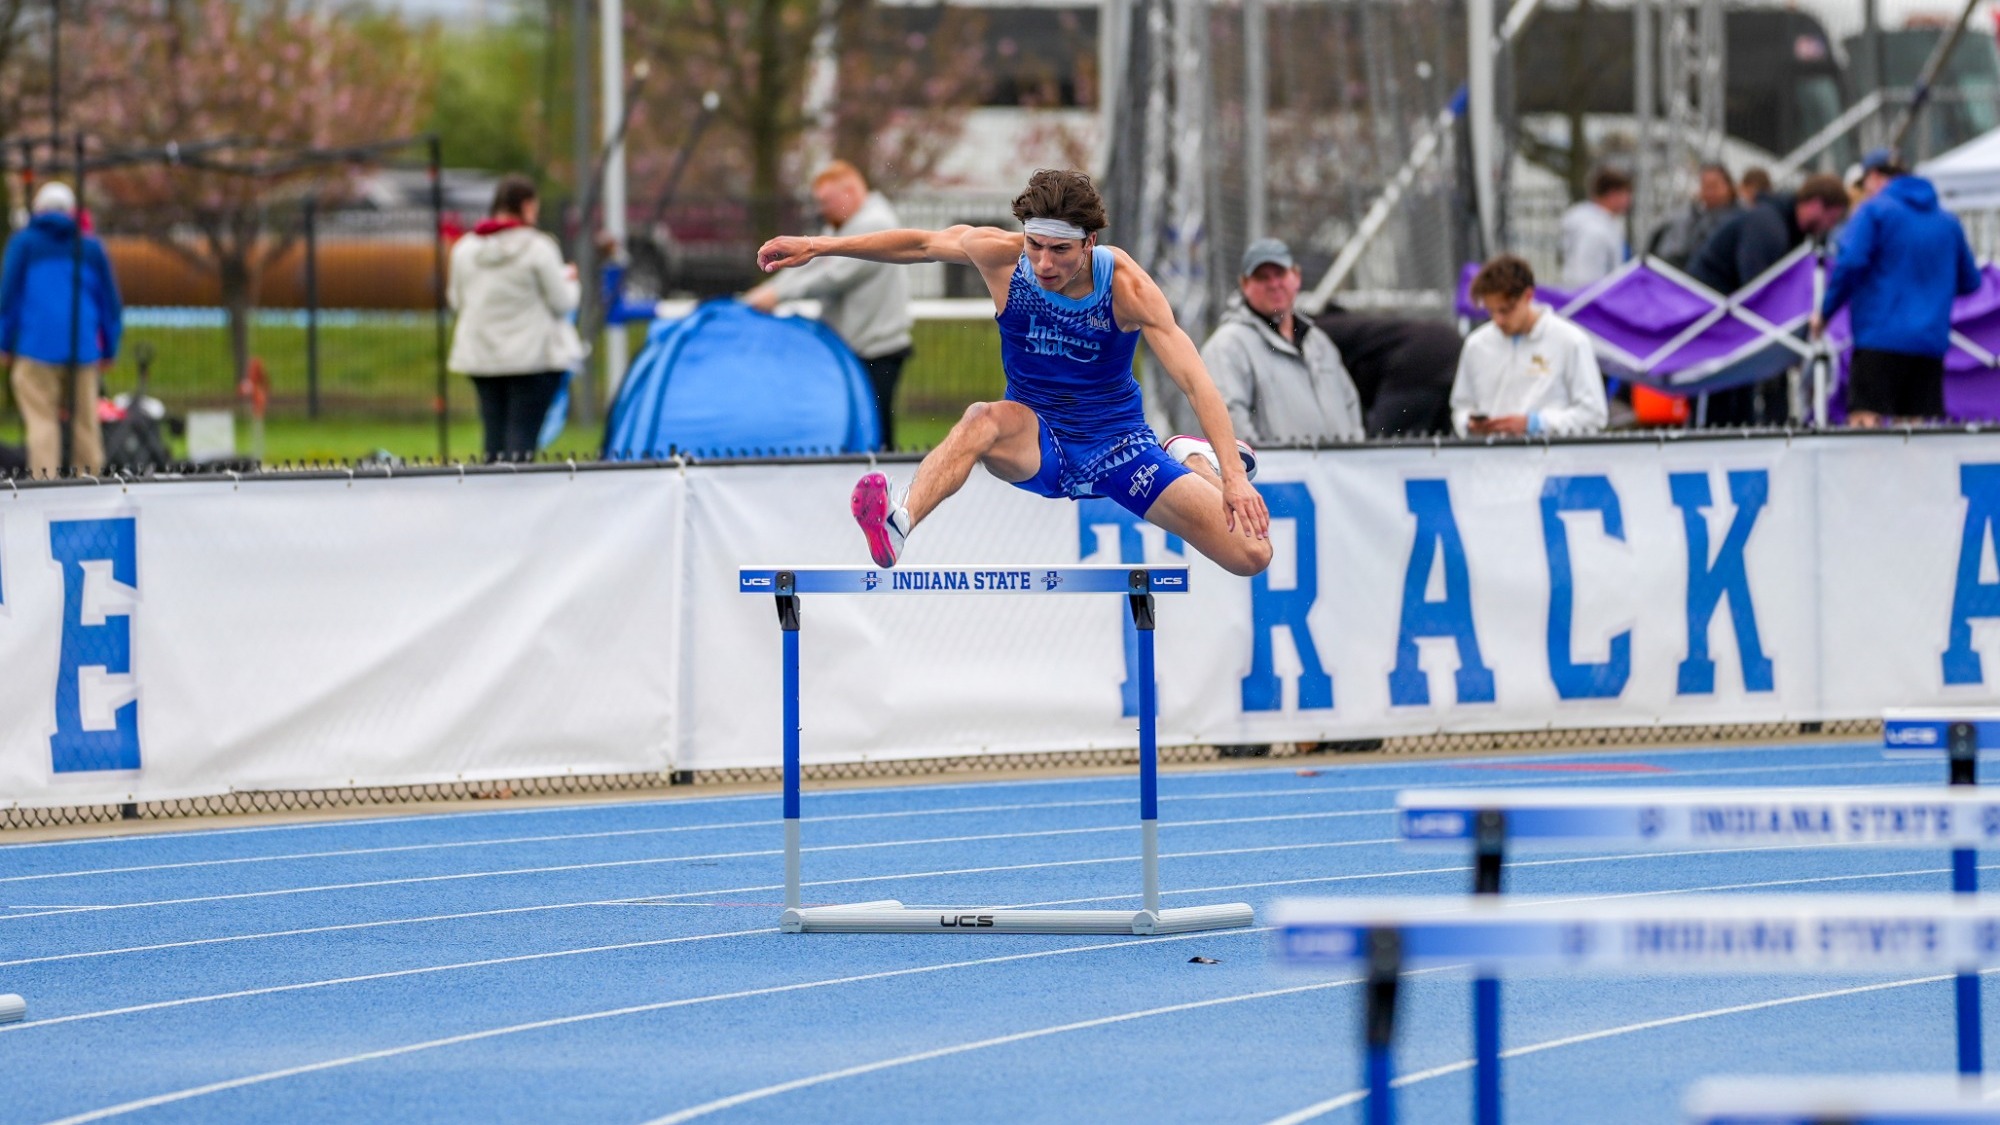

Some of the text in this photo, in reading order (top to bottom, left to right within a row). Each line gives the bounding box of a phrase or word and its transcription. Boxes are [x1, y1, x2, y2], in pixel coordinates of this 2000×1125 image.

[1026, 314, 1101, 350] Indiana
[1025, 337, 1094, 362] State
[742, 577, 771, 586] UCS
[892, 571, 1031, 590] INDIANA STATE
[1153, 577, 1183, 585] UCS
[0, 515, 141, 773] E
[1078, 469, 1775, 718] TRACK
[941, 915, 994, 927] UCS
